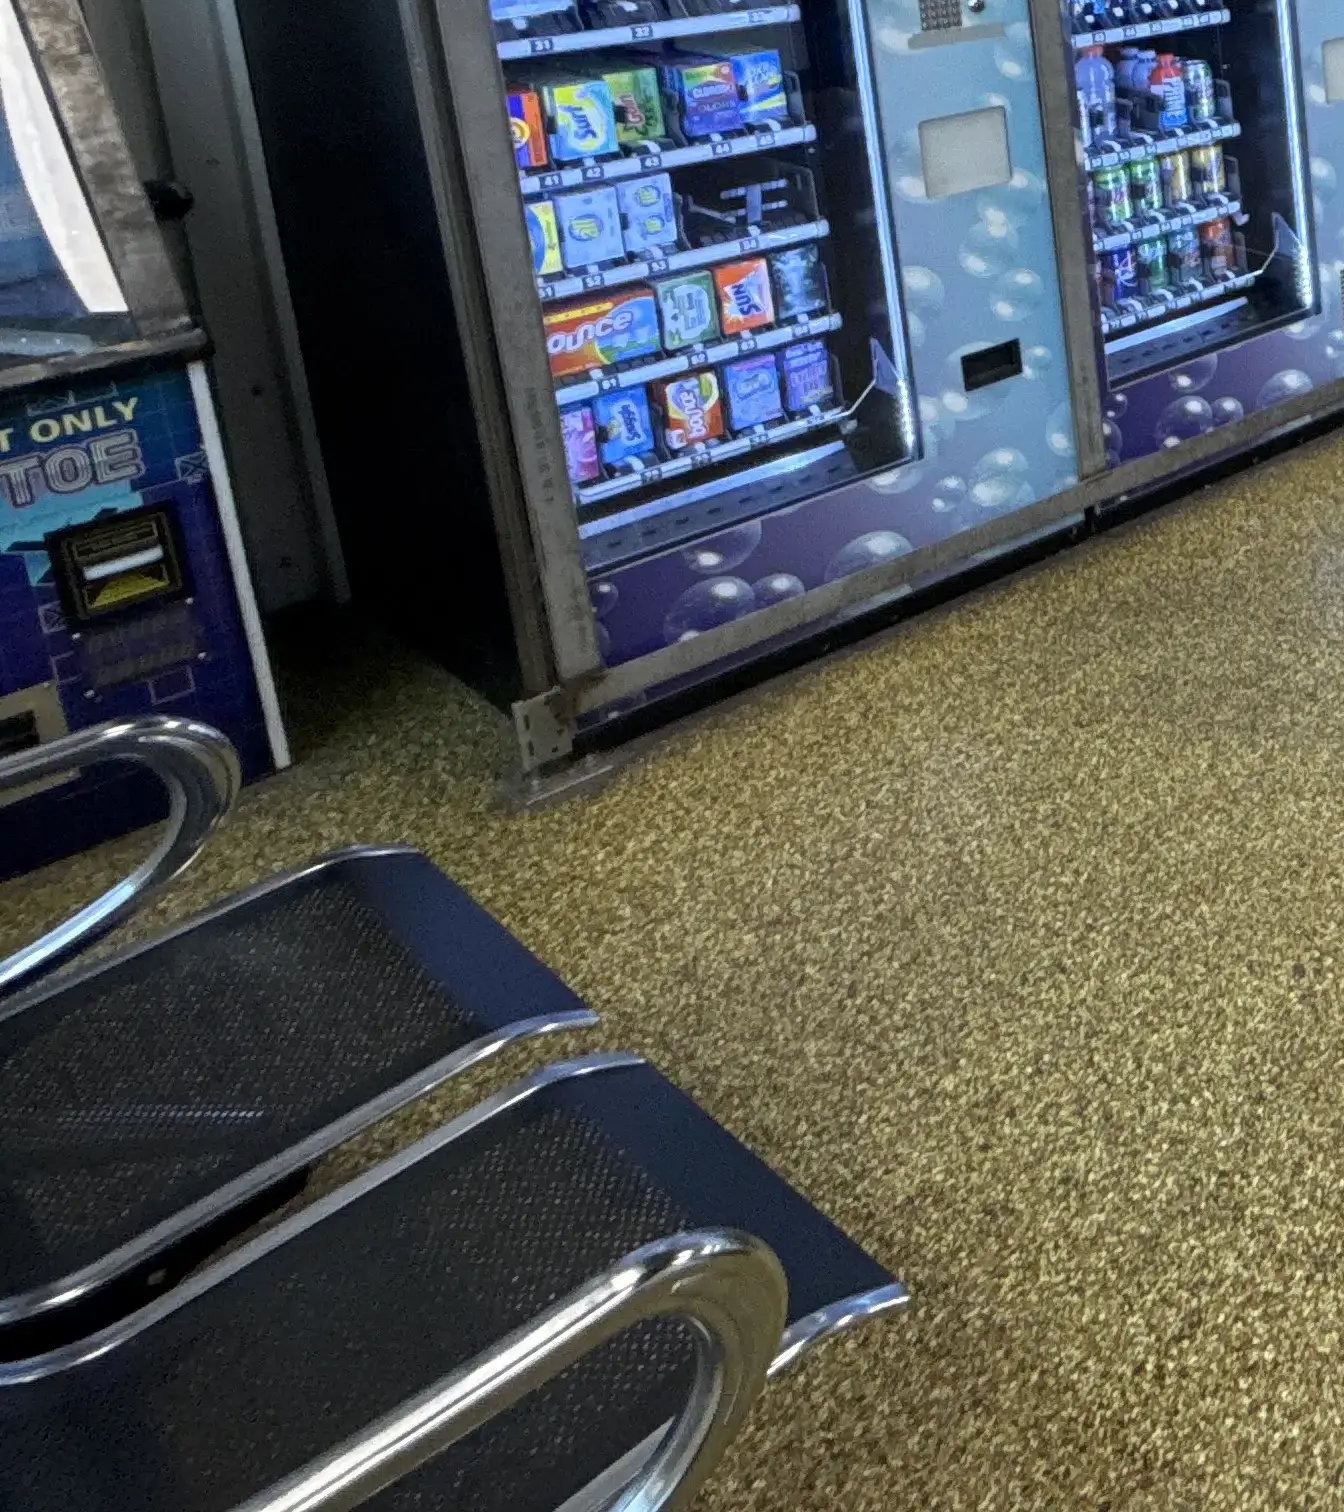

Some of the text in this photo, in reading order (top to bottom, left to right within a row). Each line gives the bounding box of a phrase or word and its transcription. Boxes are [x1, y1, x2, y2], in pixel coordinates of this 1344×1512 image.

[556, 104, 598, 141] Surf
[543, 174, 560, 186] 41
[586, 167, 602, 179] 42
[731, 282, 763, 317] SUN
[547, 310, 634, 355] ounce
[30, 397, 138, 443] ONLY
[0, 428, 147, 508] TOE
